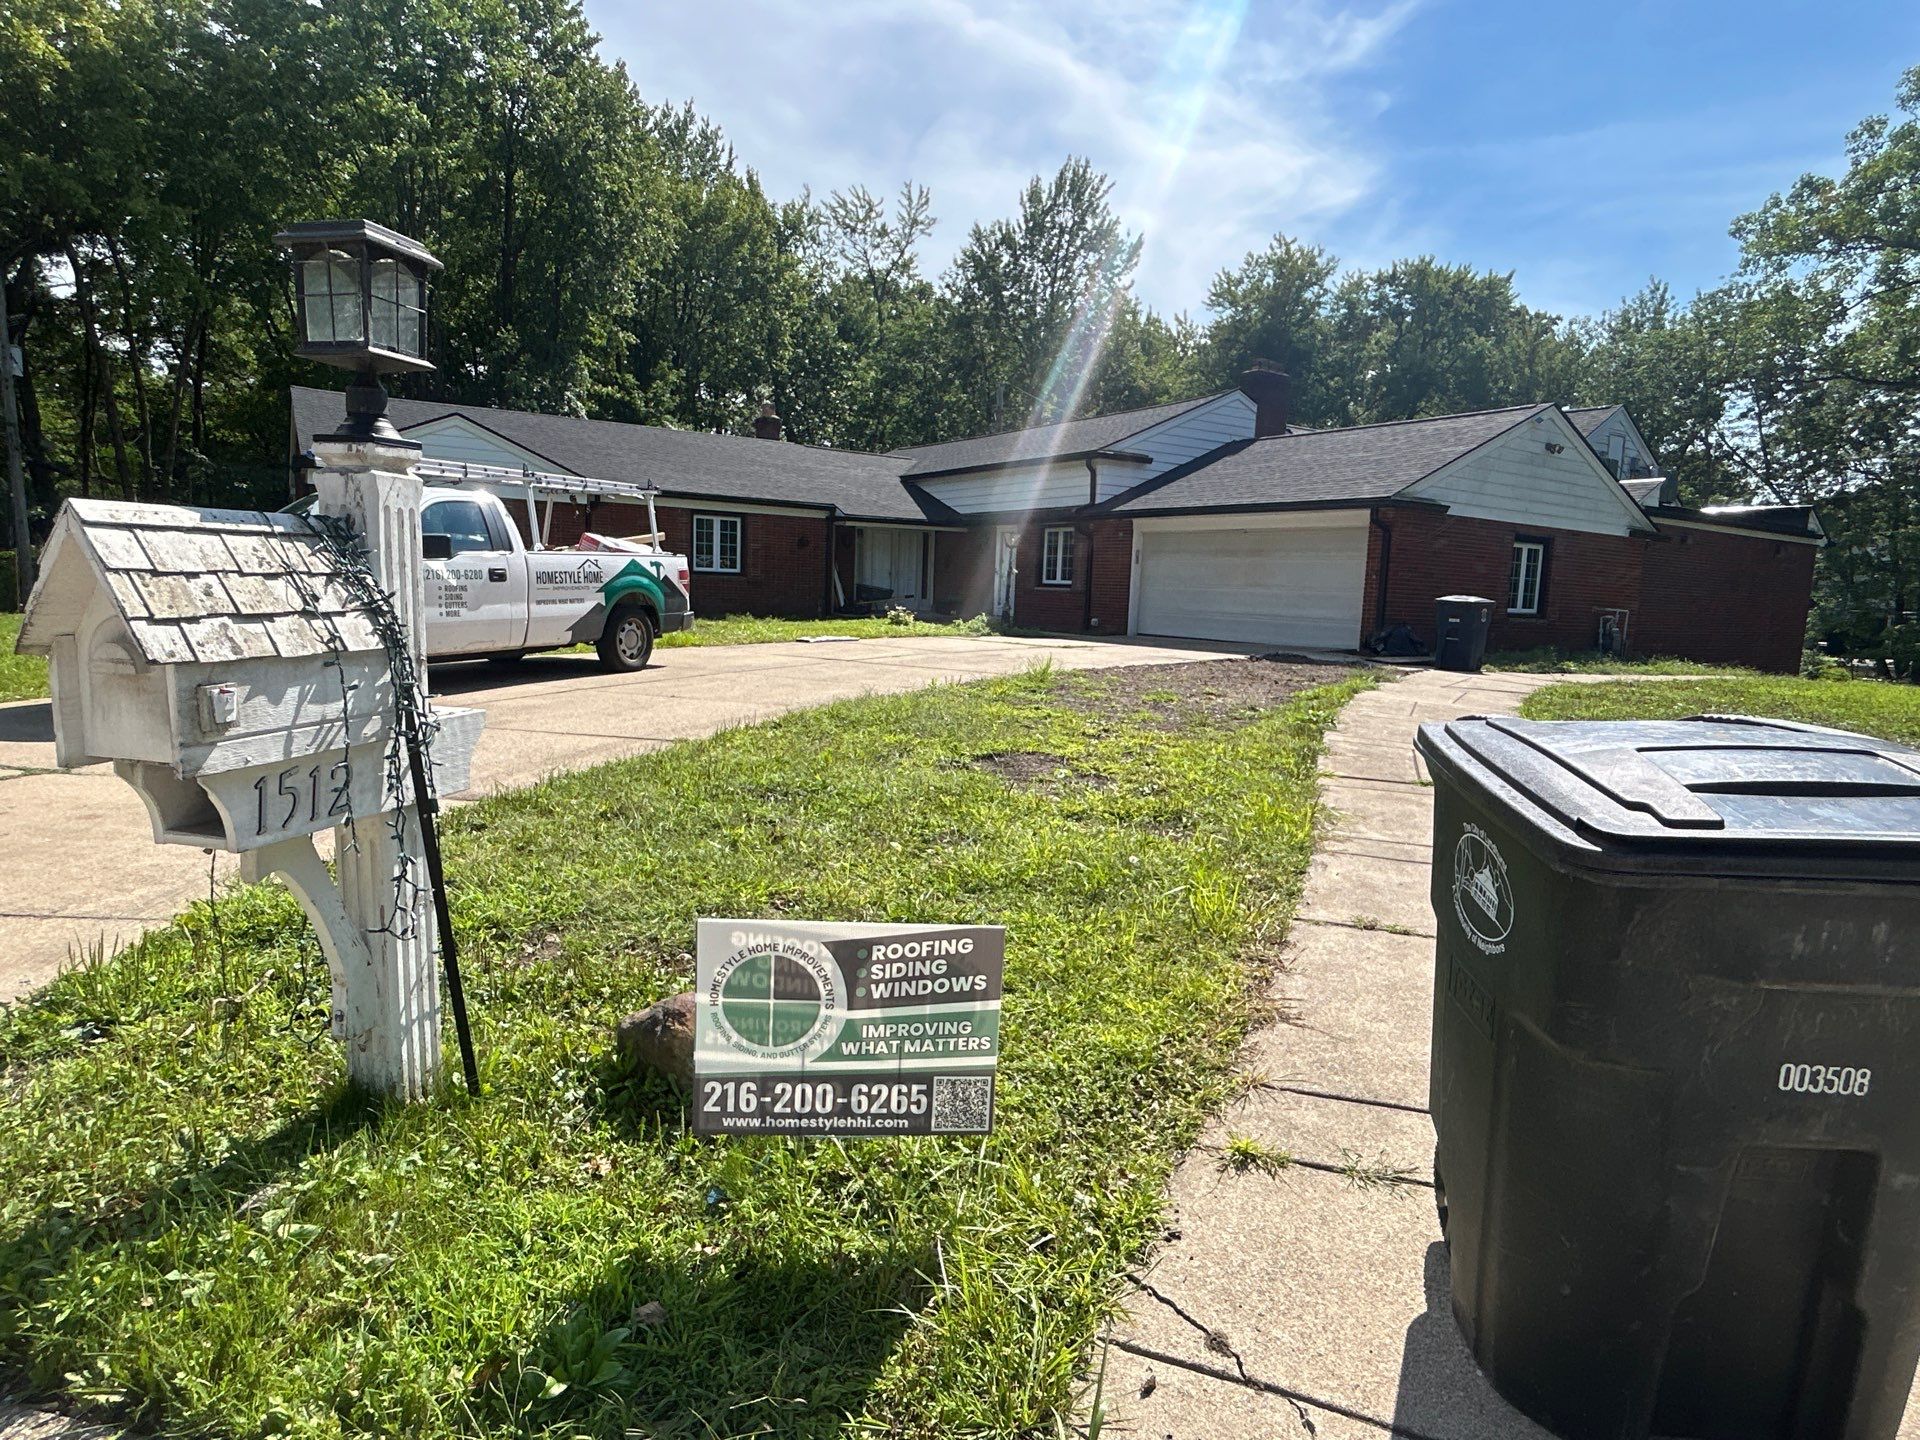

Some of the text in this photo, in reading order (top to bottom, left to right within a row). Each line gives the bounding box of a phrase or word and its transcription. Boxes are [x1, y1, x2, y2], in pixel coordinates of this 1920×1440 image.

[446, 569, 483, 580] 200-6280
[536, 566, 604, 584] HOMESTYLE HOME
[444, 593, 463, 601] SIDING
[444, 601, 468, 609] GUTTERS
[253, 761, 352, 836] 1512
[871, 938, 974, 961] ROOFING
[1477, 937, 1505, 956] Neighbors
[709, 950, 747, 1007] HOMESTYLE
[747, 943, 780, 956] HOME
[782, 943, 835, 1010] IMPROVEMENTS
[870, 959, 948, 980] SIDING
[870, 974, 988, 1000] WINDOWS
[732, 1041, 759, 1058] SIDING,
[779, 1043, 811, 1059] GUTTER
[808, 1014, 833, 1046] SYSTEMS
[862, 1021, 972, 1039] IMPROVING
[842, 1036, 992, 1056] WHAT MATTERS
[1778, 1063, 1872, 1096] 003508
[703, 1081, 928, 1115] 216-200-6265
[722, 1115, 909, 1131] www.homestylehhi.com
